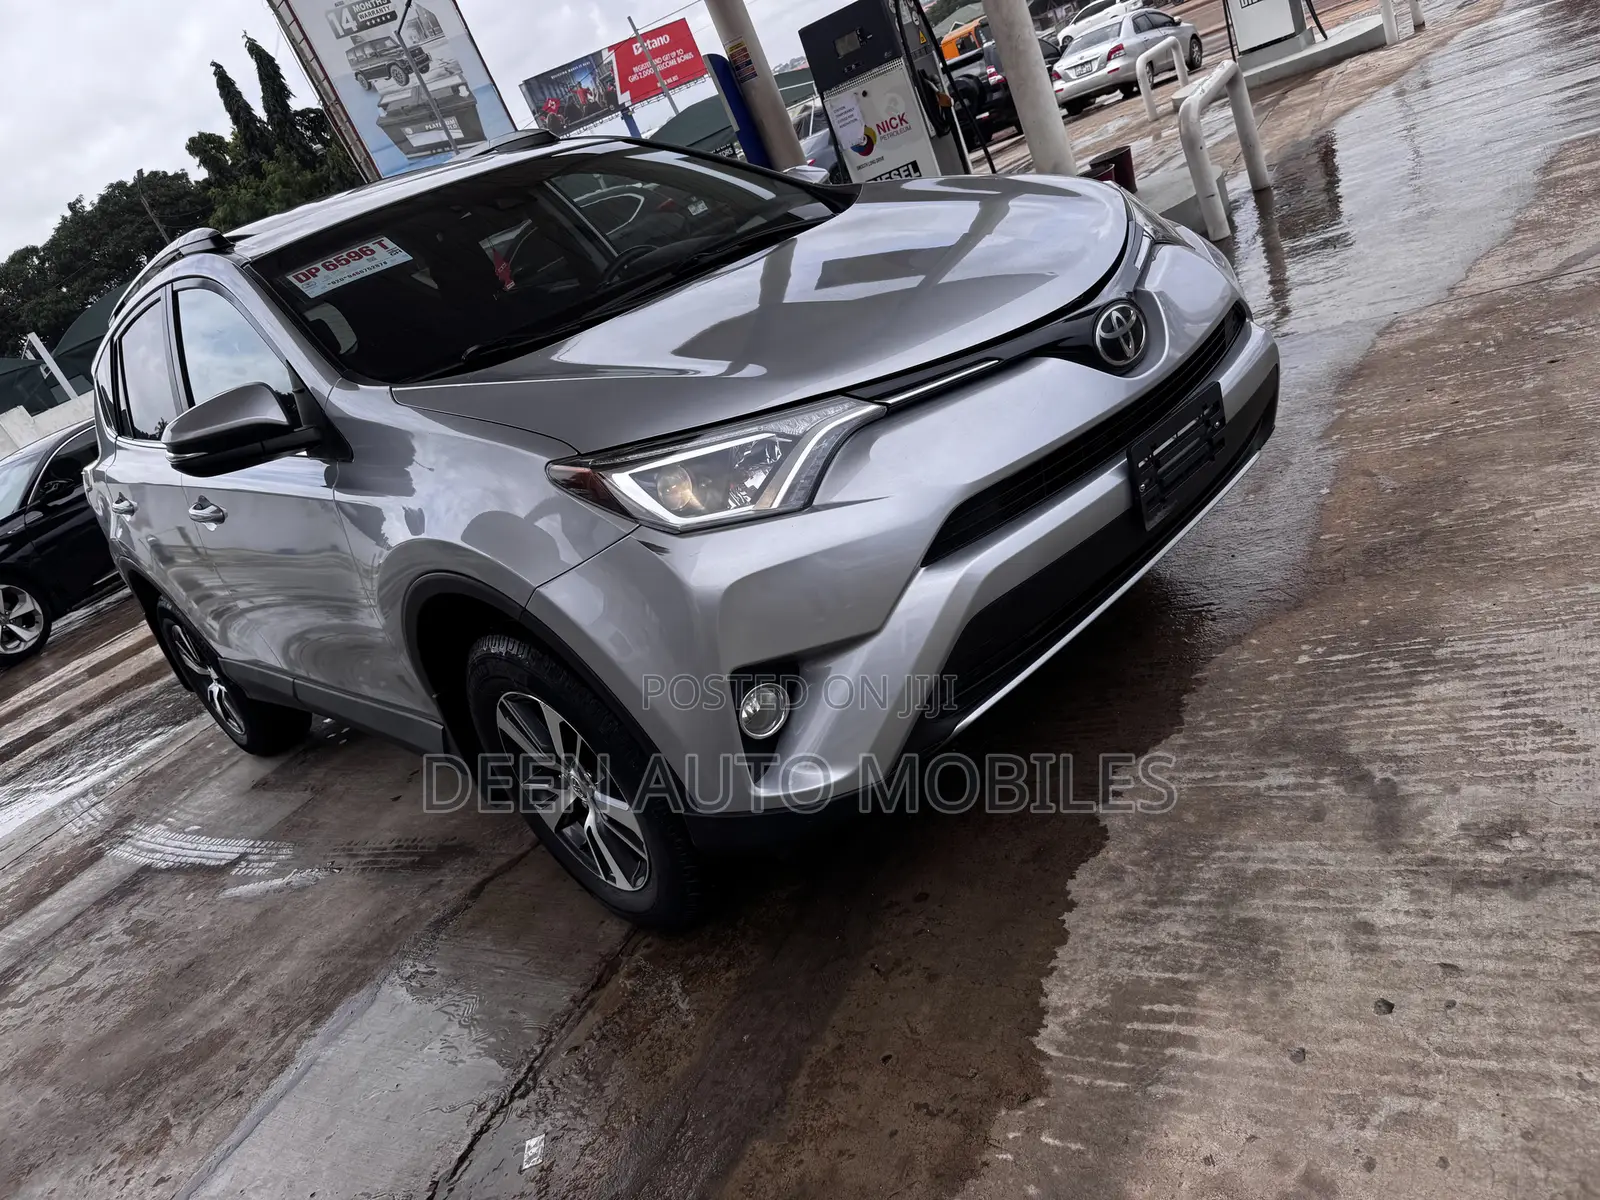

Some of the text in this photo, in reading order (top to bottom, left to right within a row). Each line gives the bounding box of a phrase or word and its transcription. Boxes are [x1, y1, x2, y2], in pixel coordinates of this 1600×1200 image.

[327, 7, 358, 36] 14
[359, 5, 391, 20] WARRANTY
[876, 112, 909, 136] NICK
[880, 125, 912, 142] PETROLEUM
[292, 239, 389, 284] DP 6596 T
